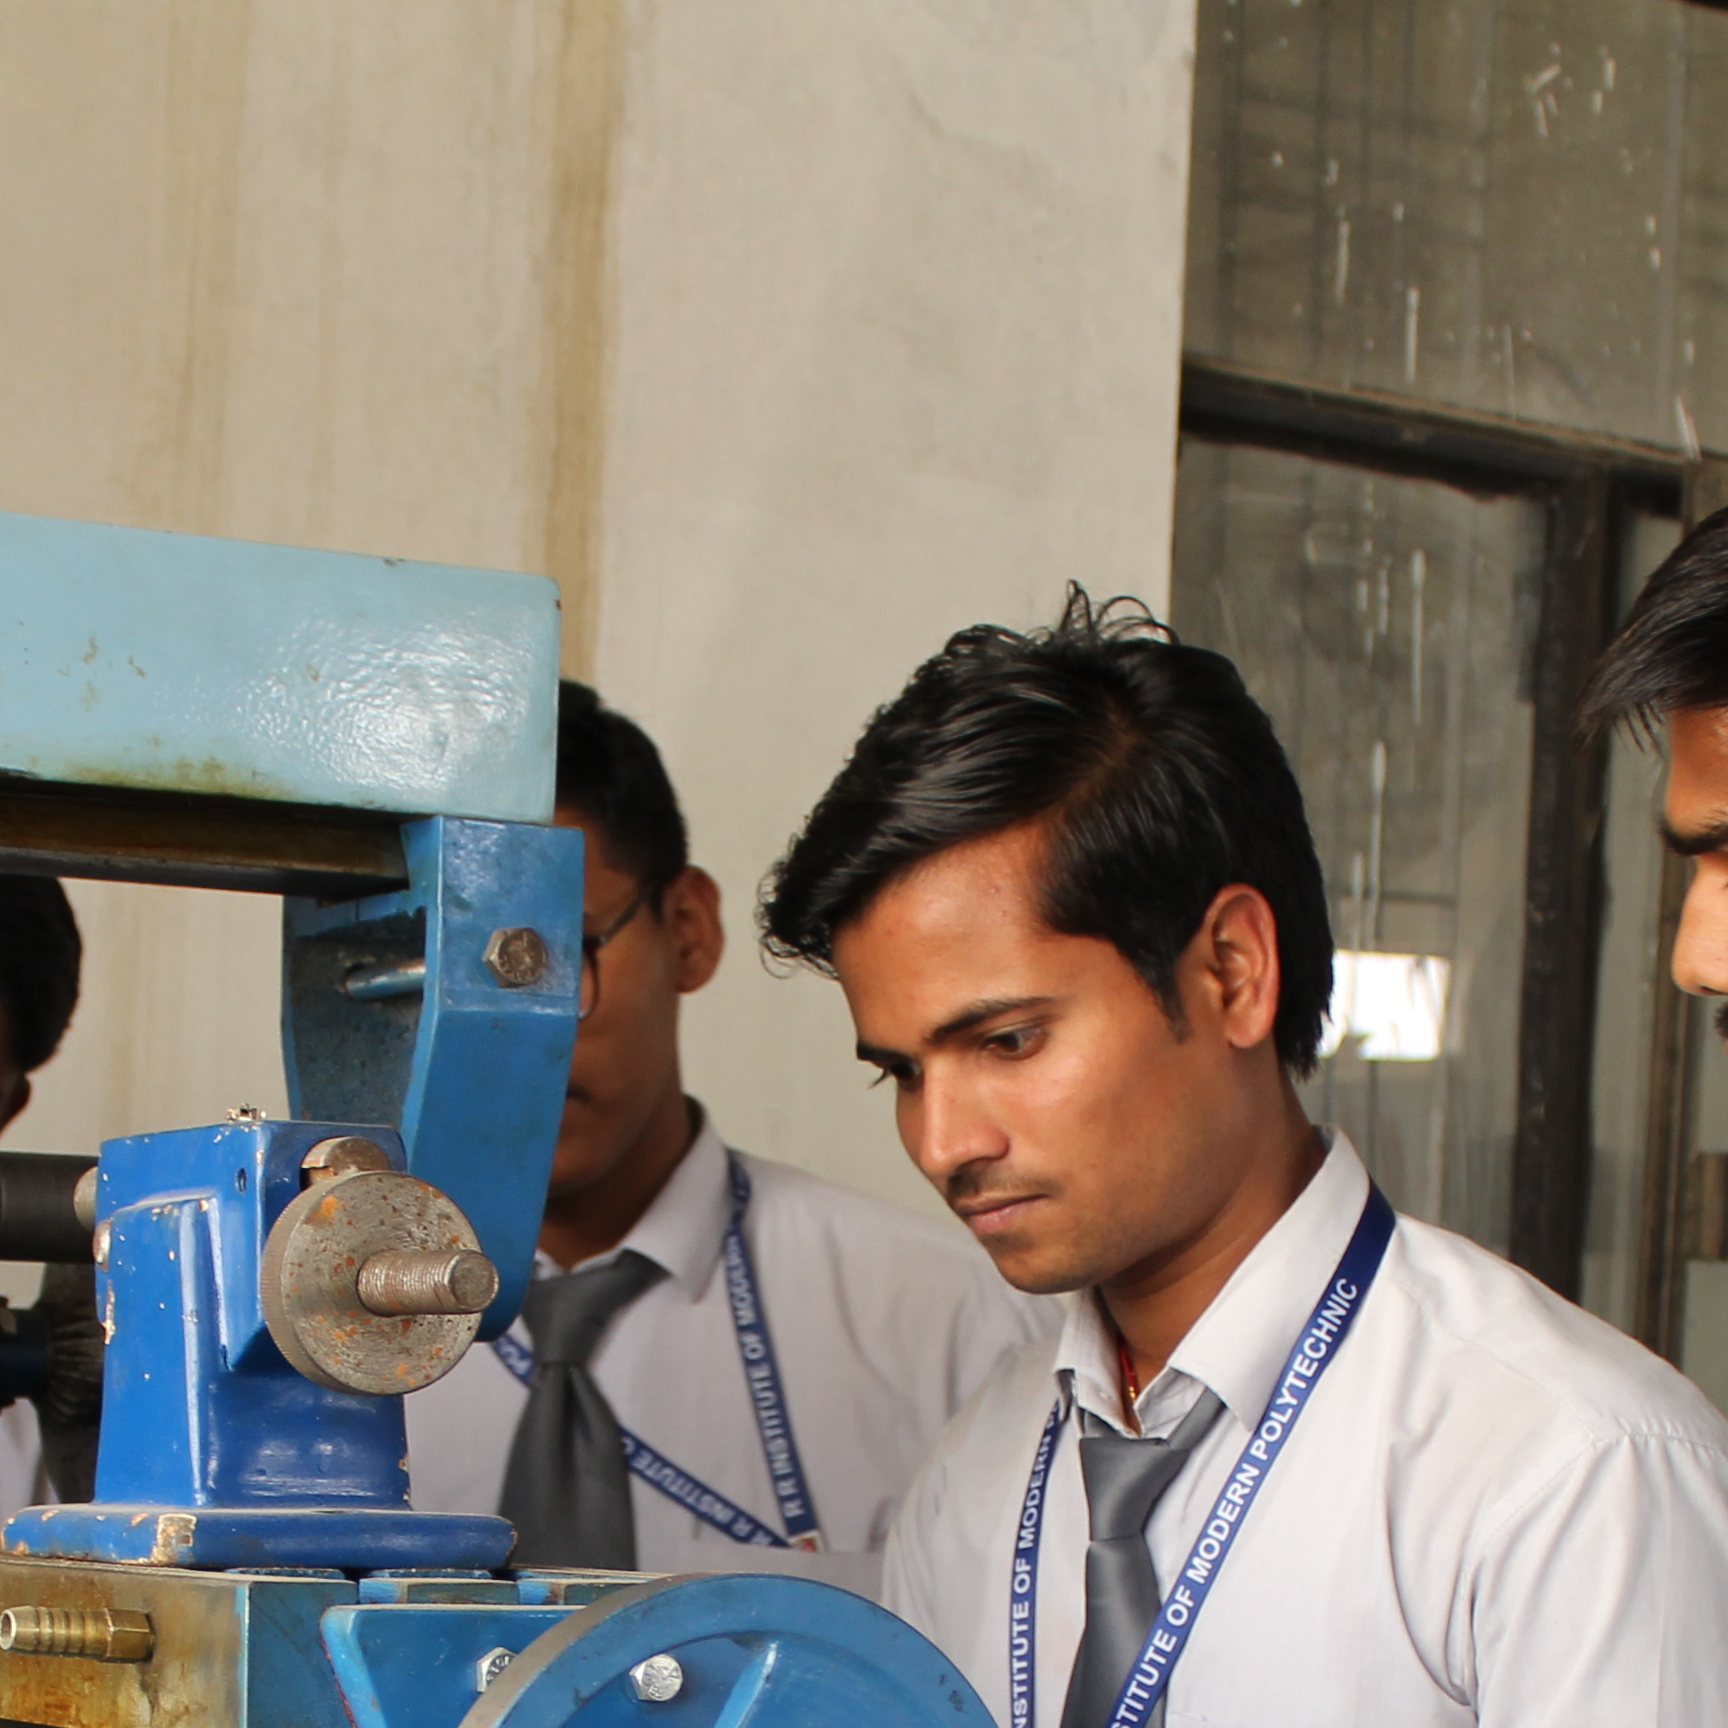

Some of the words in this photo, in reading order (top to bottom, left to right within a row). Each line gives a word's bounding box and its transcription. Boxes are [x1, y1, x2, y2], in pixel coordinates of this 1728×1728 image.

[1166, 1585, 1195, 1627] OF
[1186, 1463, 1261, 1584] MODERN
[1250, 1279, 1358, 1462] POLYTECHNIC
[1014, 1558, 1032, 1594] OF
